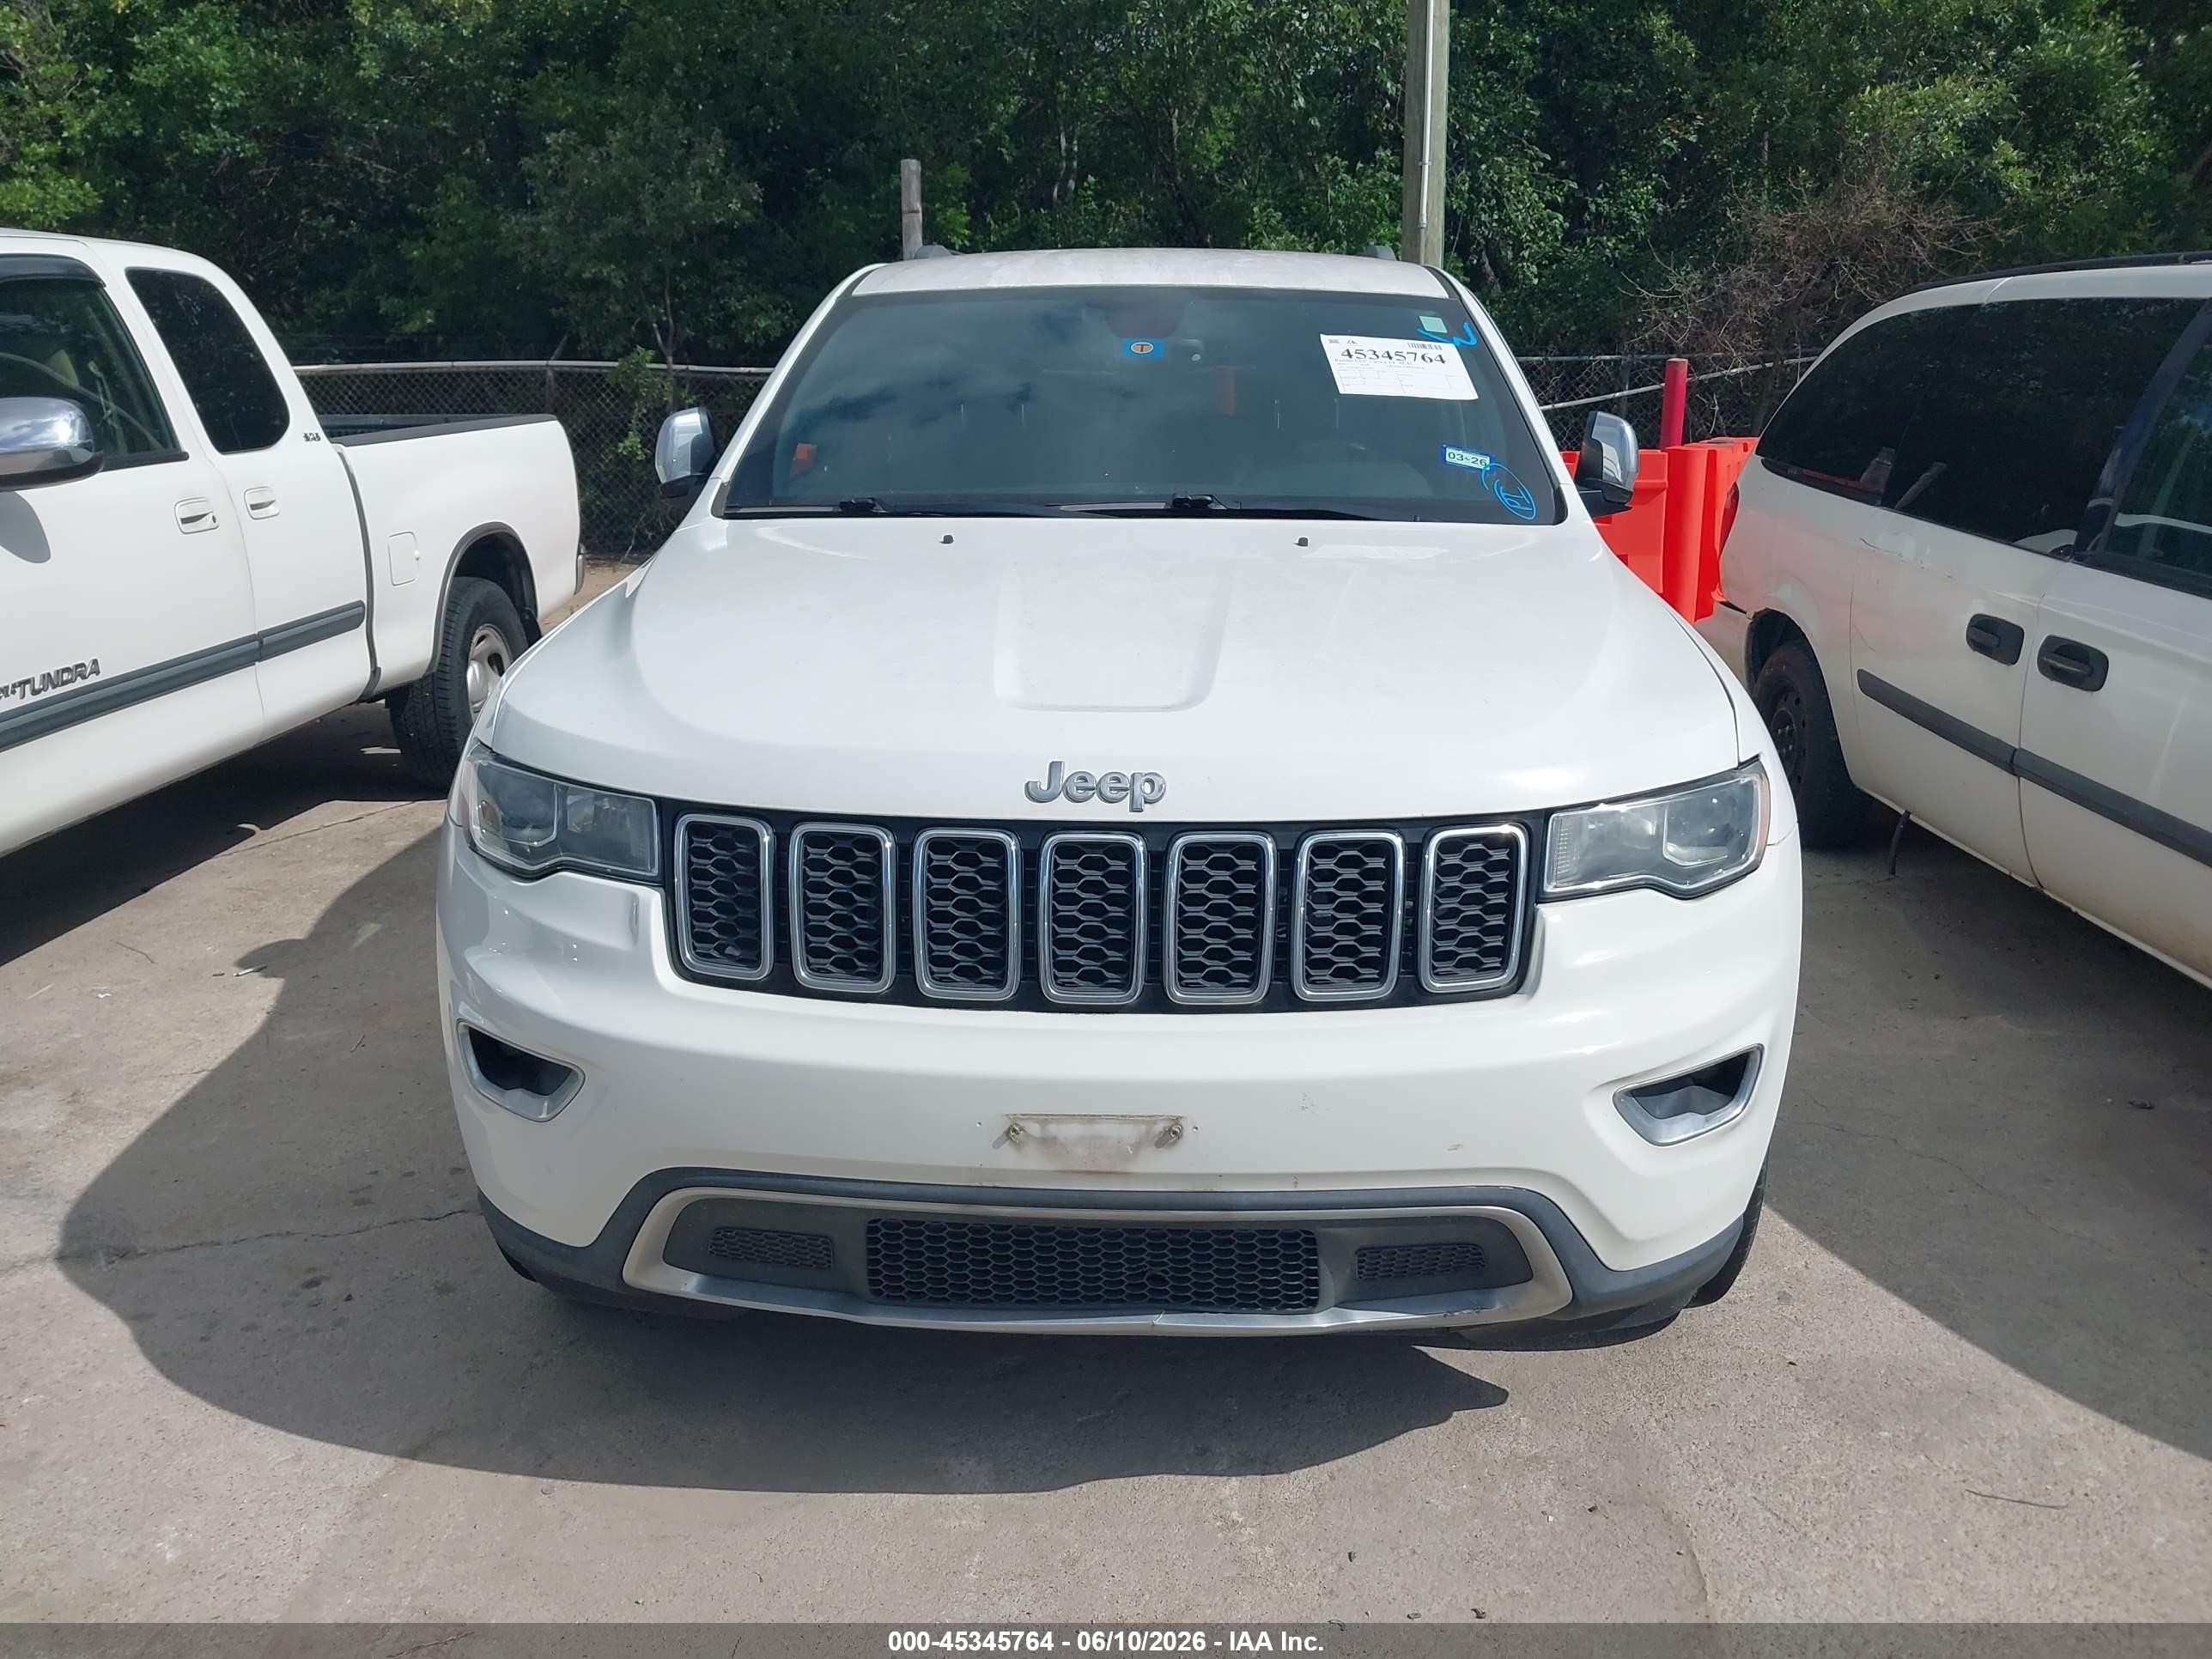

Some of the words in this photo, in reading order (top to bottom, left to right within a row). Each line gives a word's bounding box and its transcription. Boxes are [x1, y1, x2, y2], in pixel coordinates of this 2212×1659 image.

[1340, 348, 1447, 365] 45345764
[12, 658, 101, 700] TUNDRA
[1024, 761, 1166, 812] Jeep
